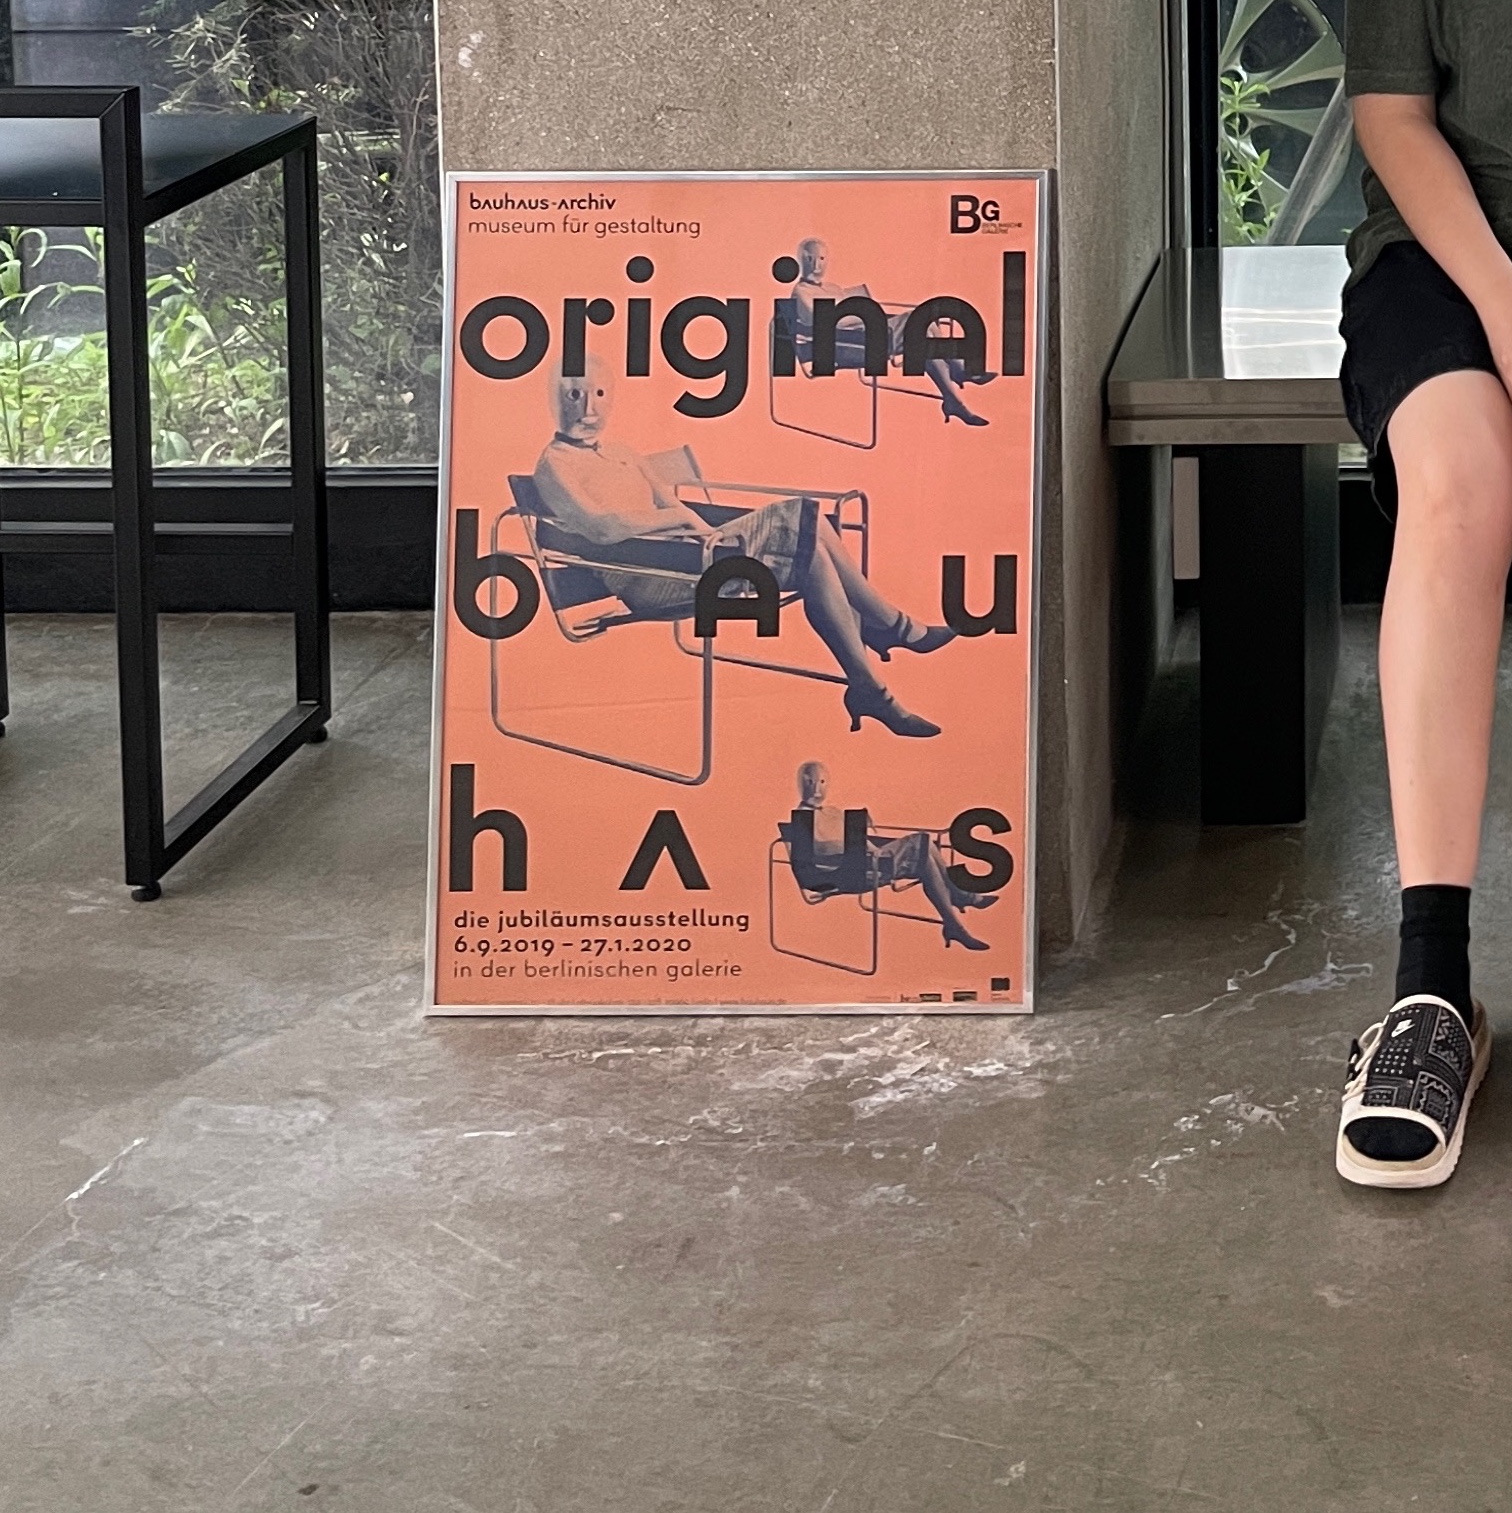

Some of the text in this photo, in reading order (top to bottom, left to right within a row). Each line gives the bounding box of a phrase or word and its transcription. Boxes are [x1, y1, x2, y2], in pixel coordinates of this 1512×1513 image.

[468, 214, 701, 239] museum für gestaltung
[459, 250, 1027, 419] original
[453, 908, 750, 933] die jubiläumsausstellung
[454, 935, 555, 957] 6.9.2019
[580, 938, 692, 957] 27.1.2020
[453, 958, 743, 982] in der berlinischen galerie
